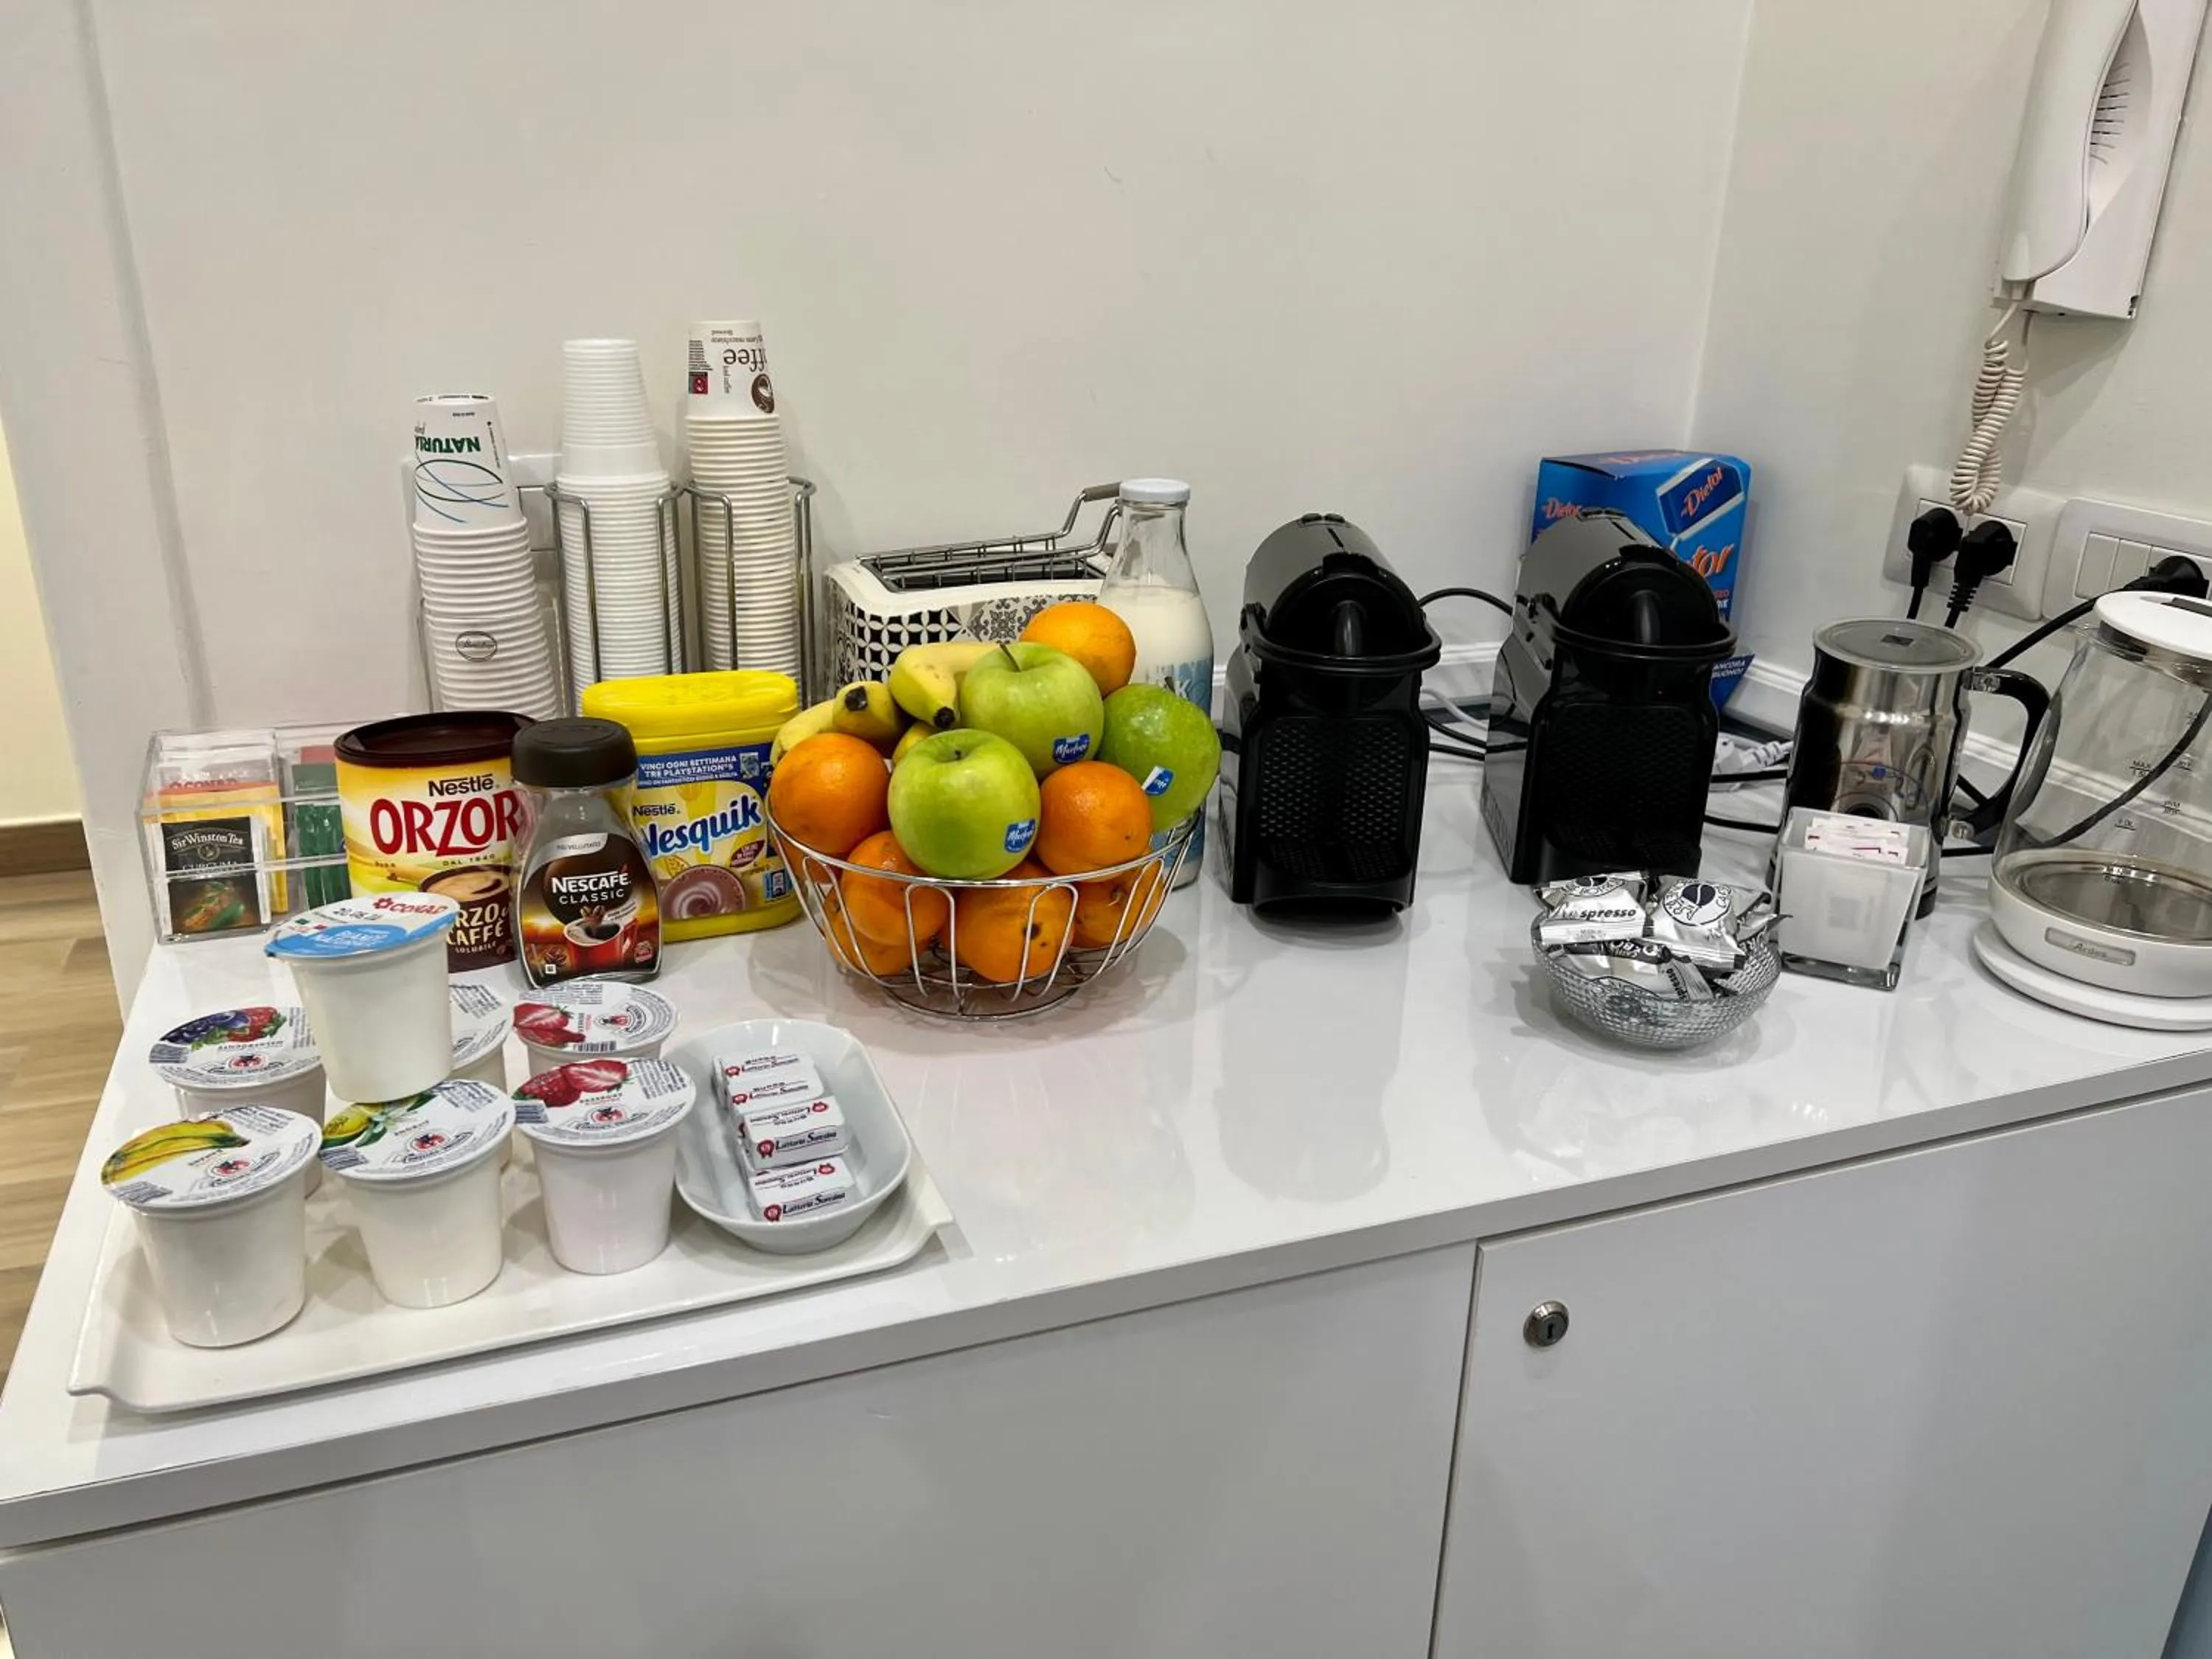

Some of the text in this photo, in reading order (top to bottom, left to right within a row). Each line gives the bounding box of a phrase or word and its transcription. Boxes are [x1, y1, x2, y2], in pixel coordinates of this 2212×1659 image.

[428, 773, 494, 796] Nestlé
[633, 803, 677, 816] Nestlé
[370, 789, 521, 857] ORZOR
[558, 888, 625, 905] CLASSIC
[455, 903, 500, 928] RZO
